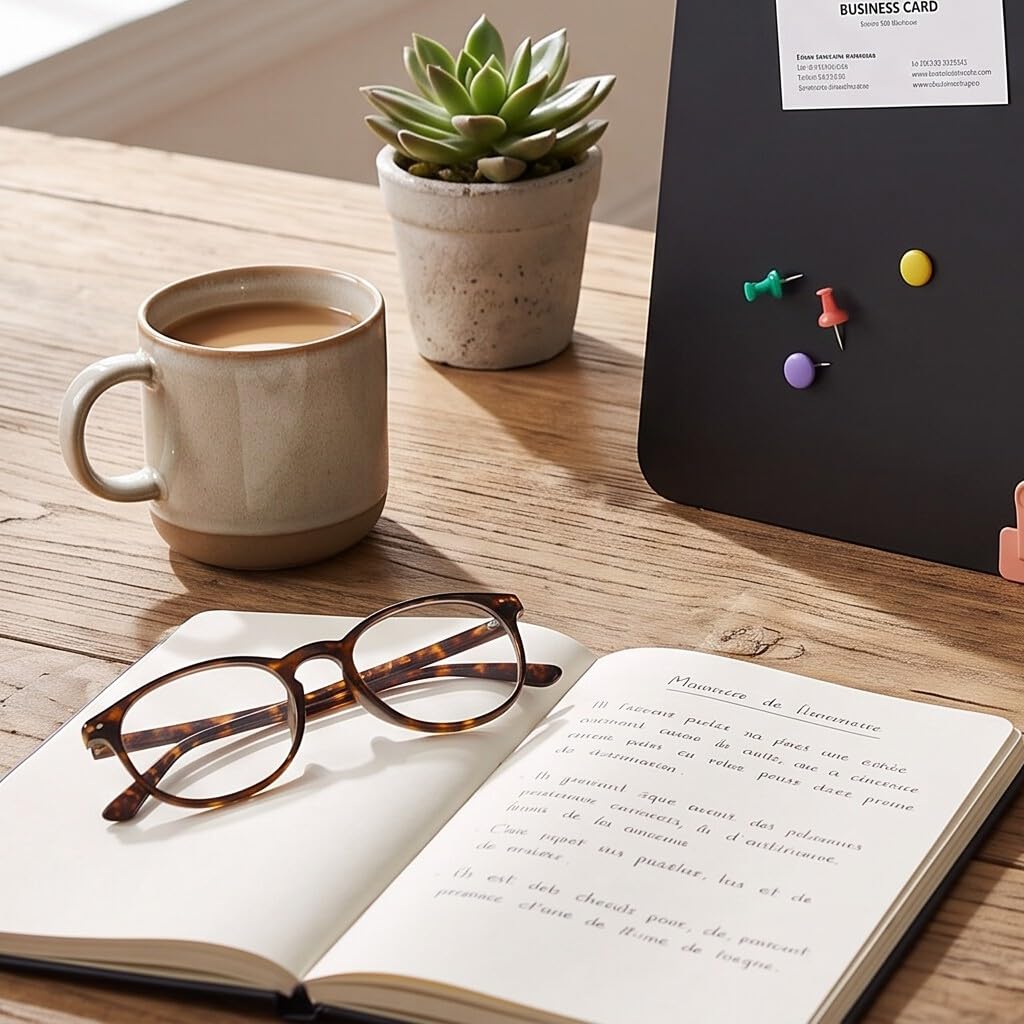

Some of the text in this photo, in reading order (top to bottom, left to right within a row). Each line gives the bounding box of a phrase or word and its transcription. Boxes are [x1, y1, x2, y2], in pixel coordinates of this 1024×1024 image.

[840, 0, 938, 16] BUSINESS CARD
[762, 698, 782, 709] de
[562, 810, 582, 821] de
